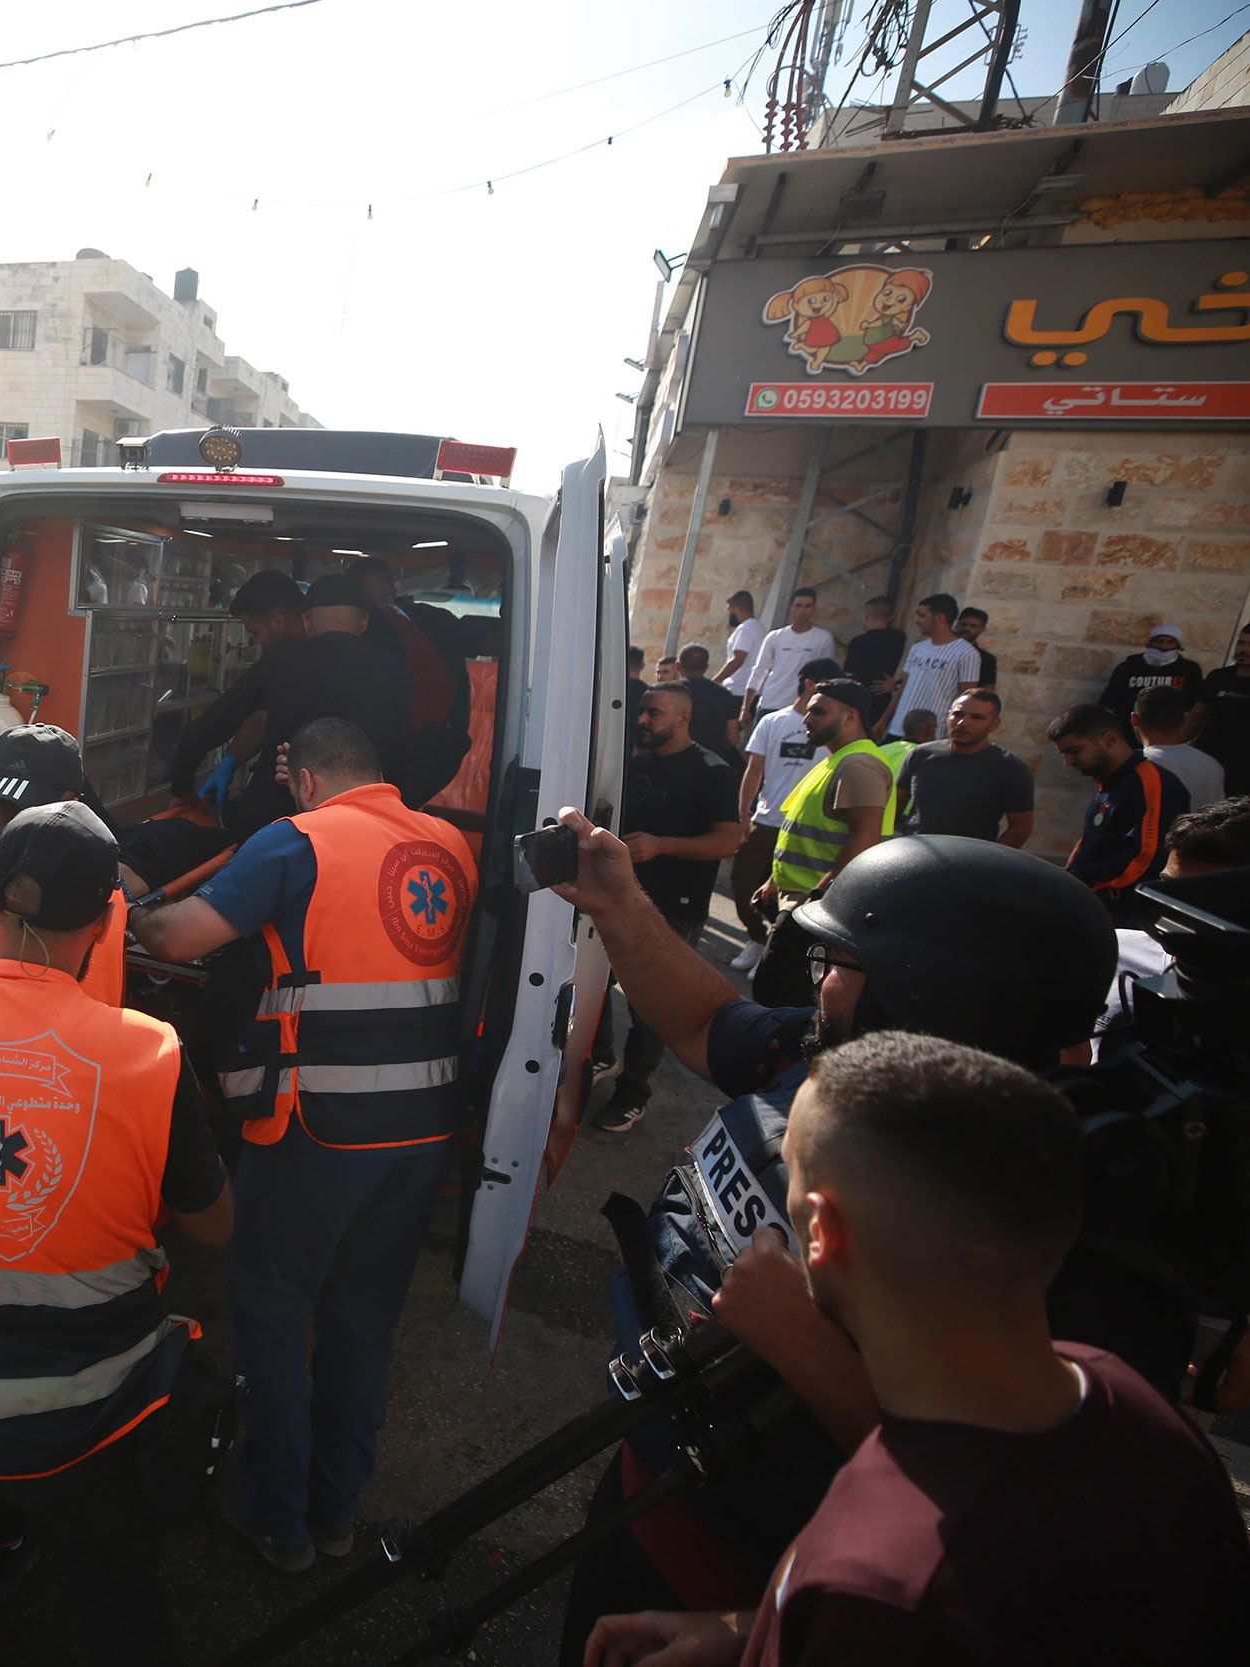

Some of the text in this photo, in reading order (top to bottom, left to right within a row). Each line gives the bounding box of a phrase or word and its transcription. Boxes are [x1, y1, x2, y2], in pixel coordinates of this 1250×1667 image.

[782, 388, 928, 410] 0593203199
[1042, 385, 1208, 415] ستاتي
[30, 1060, 51, 1072] مركز
[54, 1094, 81, 1114] وحدة
